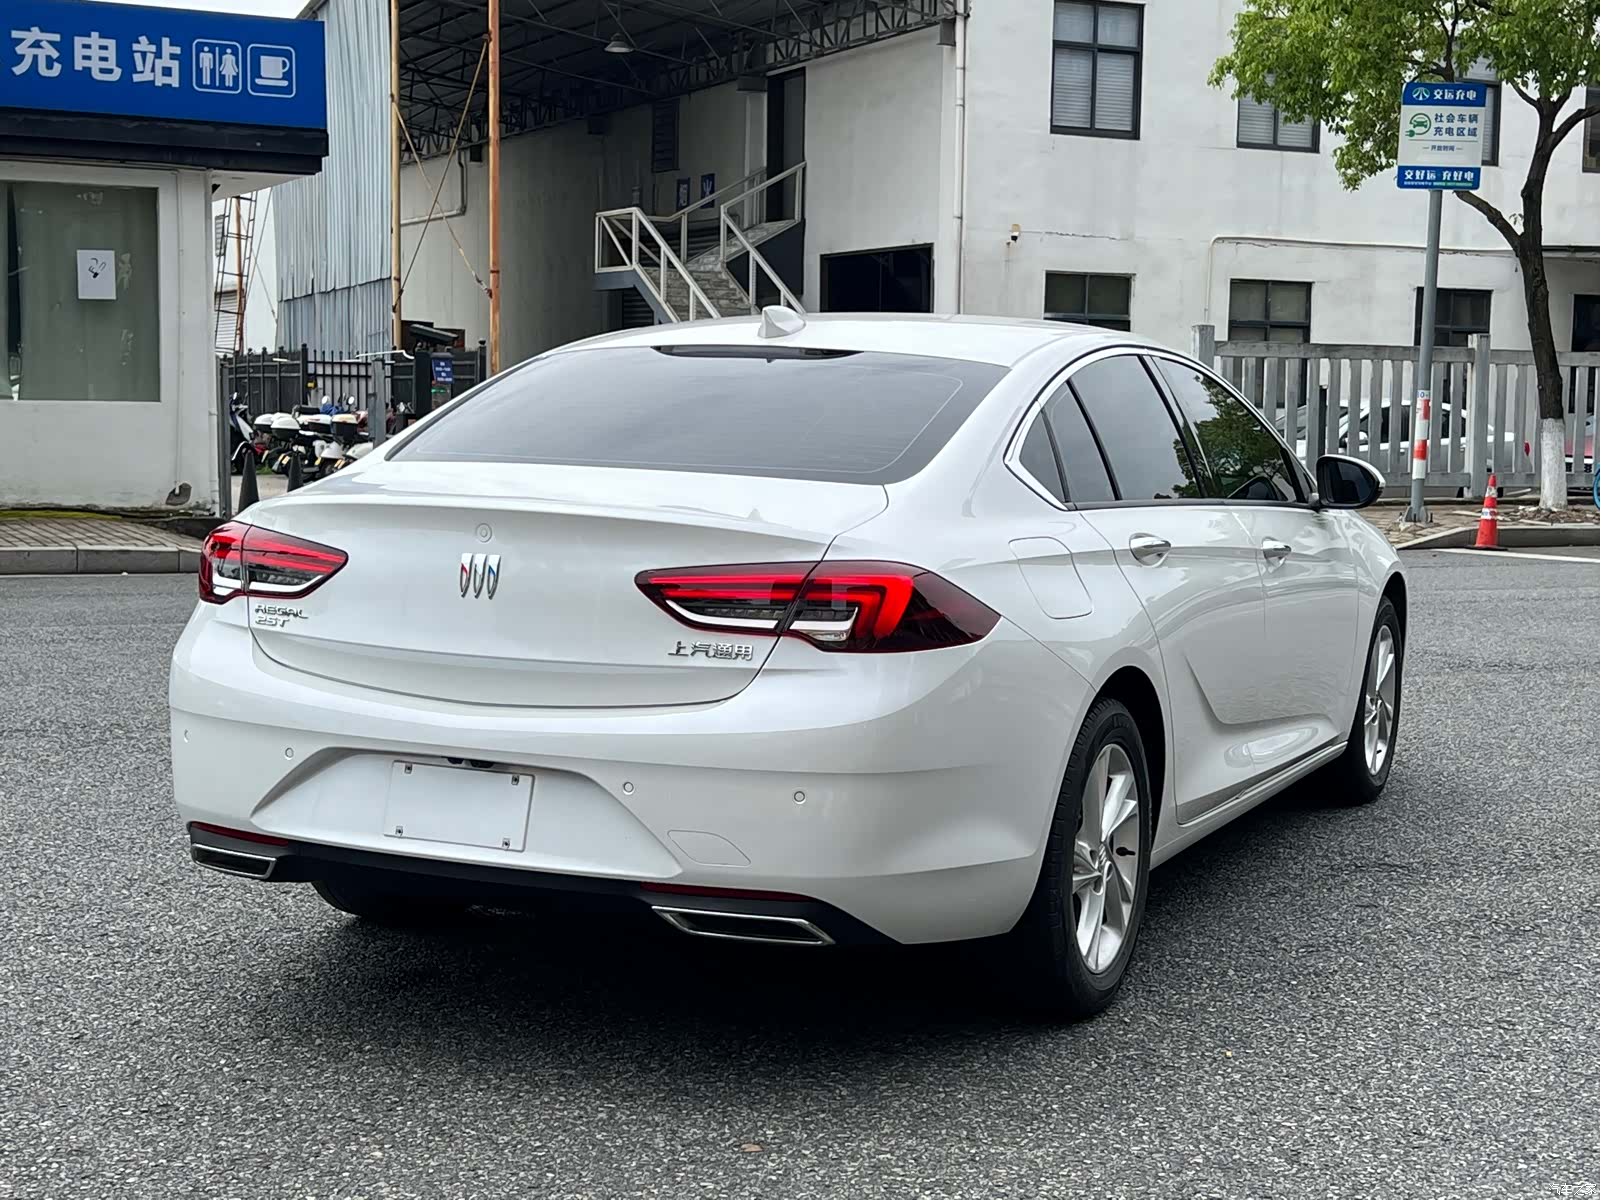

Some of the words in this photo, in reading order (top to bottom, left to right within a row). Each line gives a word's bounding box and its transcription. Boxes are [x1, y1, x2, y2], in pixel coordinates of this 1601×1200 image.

[11, 26, 182, 88] 充电站
[1433, 88, 1477, 101] 交运充电
[1434, 112, 1479, 124] 社会车辆
[1433, 126, 1478, 138] 充电区域
[1404, 169, 1437, 181] 交好运
[1442, 170, 1474, 182] 充好电
[255, 603, 309, 620] REGAL
[255, 615, 290, 628] 25T
[667, 641, 754, 662] 上汽通用
